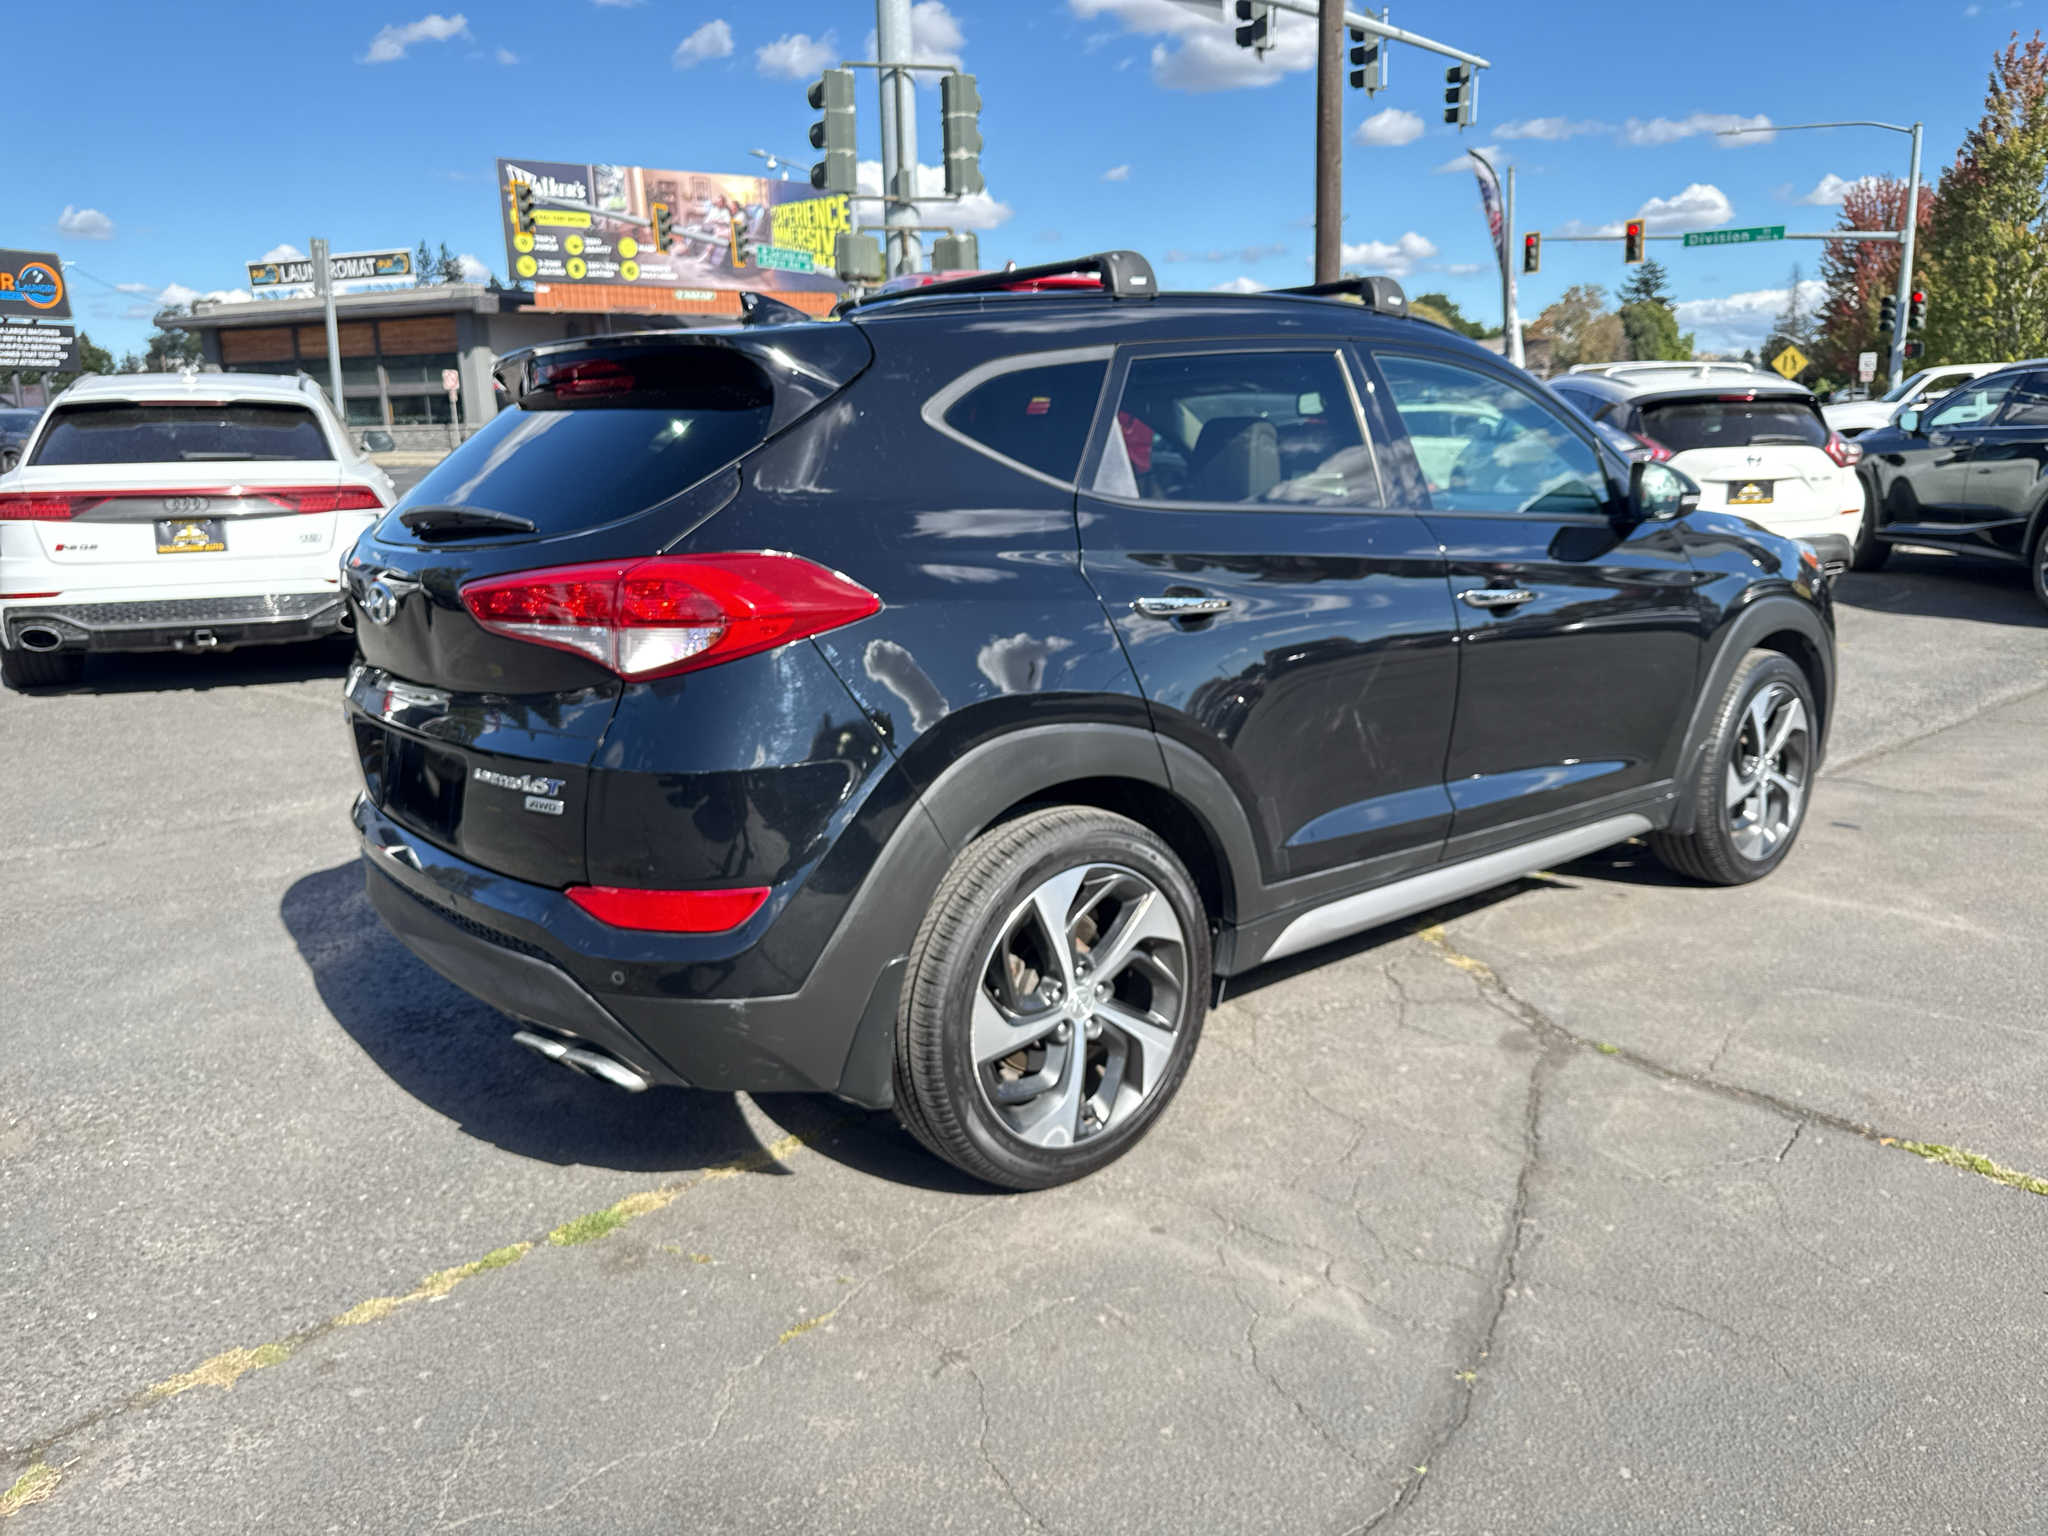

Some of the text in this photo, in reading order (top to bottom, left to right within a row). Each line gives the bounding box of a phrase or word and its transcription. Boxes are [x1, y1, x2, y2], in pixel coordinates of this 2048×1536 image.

[771, 194, 851, 230] EXPERIENCE
[773, 227, 838, 256] IMMERSIV
[1688, 230, 1750, 245] Division
[280, 258, 376, 283] LAUNROMAT
[530, 801, 557, 811] AWD
